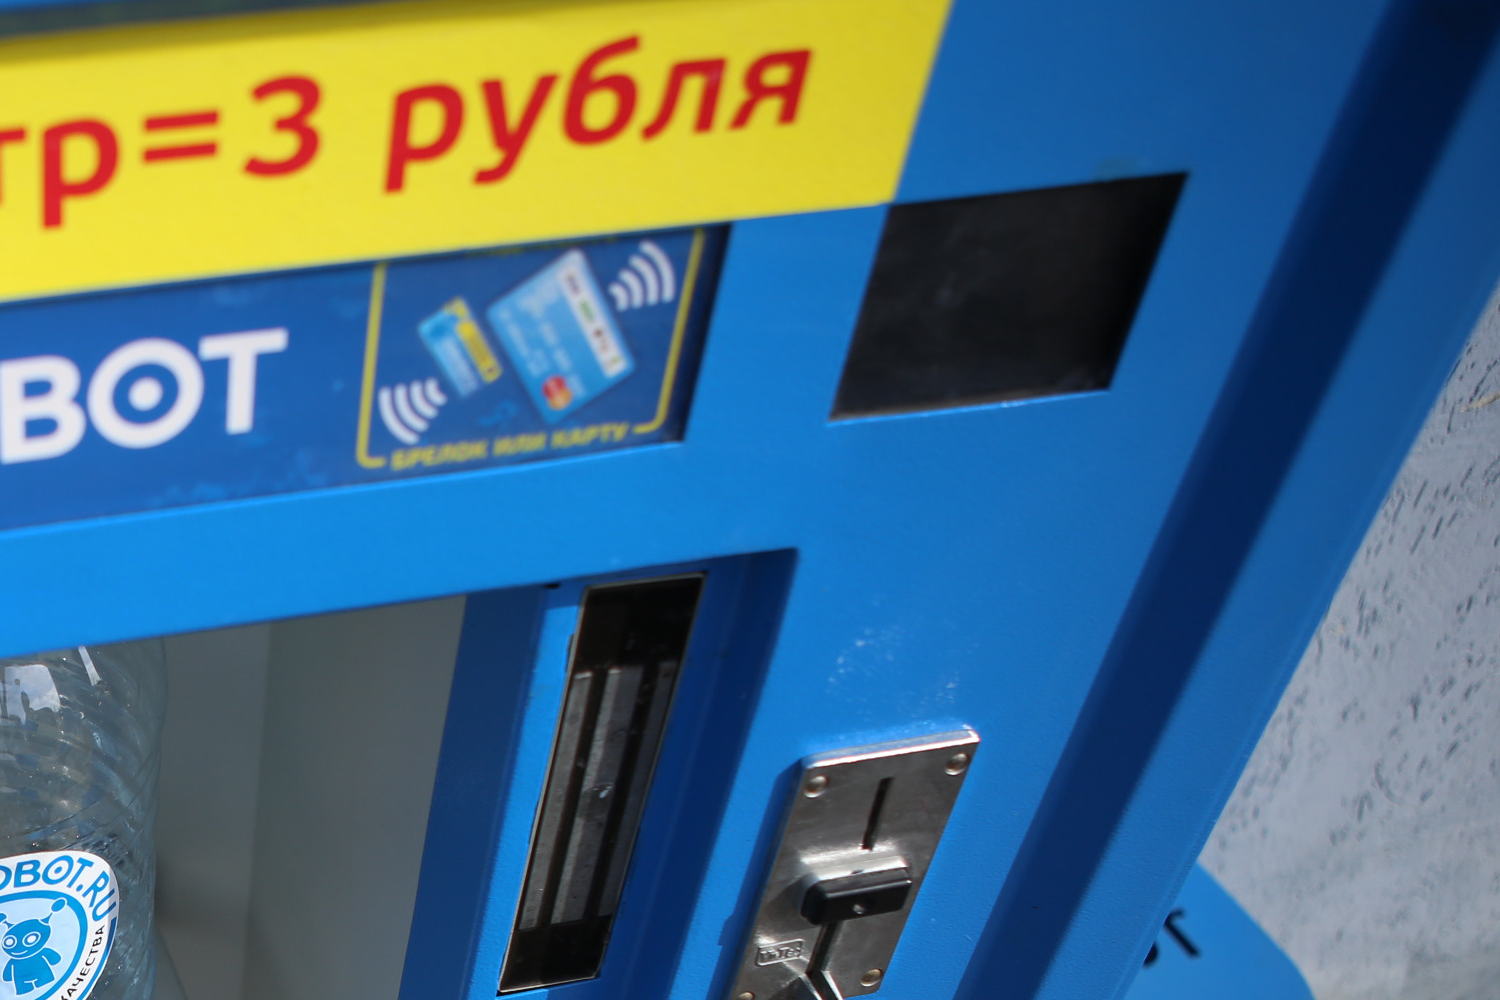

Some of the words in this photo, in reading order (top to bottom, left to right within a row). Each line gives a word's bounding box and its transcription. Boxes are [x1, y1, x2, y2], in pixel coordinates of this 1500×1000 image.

[383, 34, 813, 192] рубля
[391, 441, 488, 470] БРЕЛОК
[493, 433, 546, 457] ИЛИ
[550, 421, 629, 449] КАРТУ
